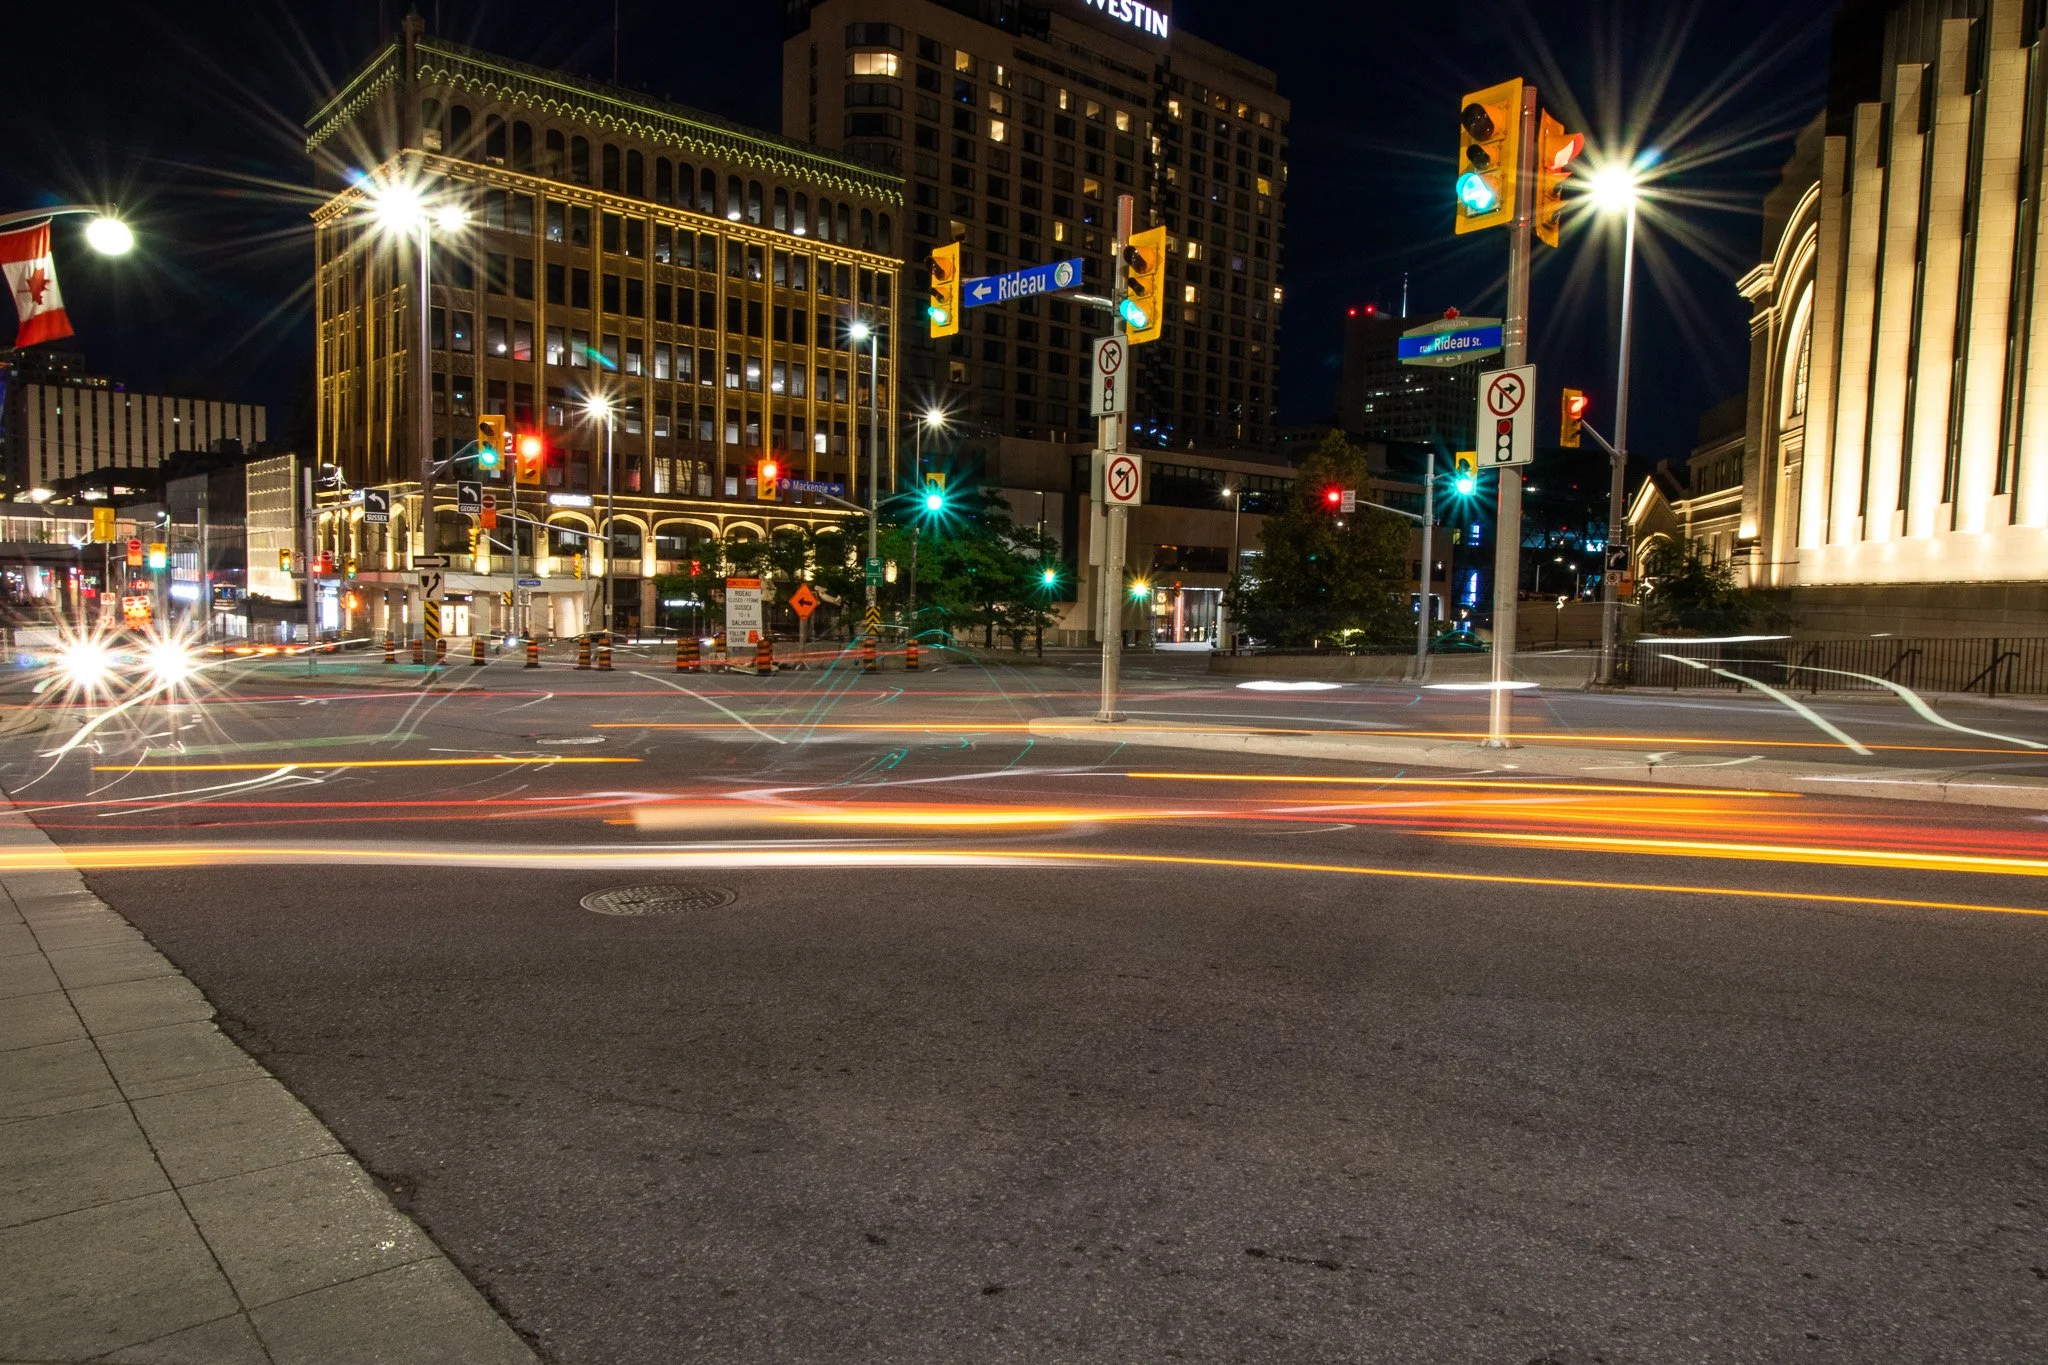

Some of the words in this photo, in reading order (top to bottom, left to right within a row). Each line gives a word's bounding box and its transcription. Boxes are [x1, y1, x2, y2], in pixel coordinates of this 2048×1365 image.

[998, 272, 1046, 300] Rideau
[1419, 345, 1432, 354] rue
[1434, 335, 1470, 352] Rideau
[792, 480, 828, 494] Mackenzie
[460, 505, 480, 513] GEORGE
[366, 514, 388, 522] SUSSEX
